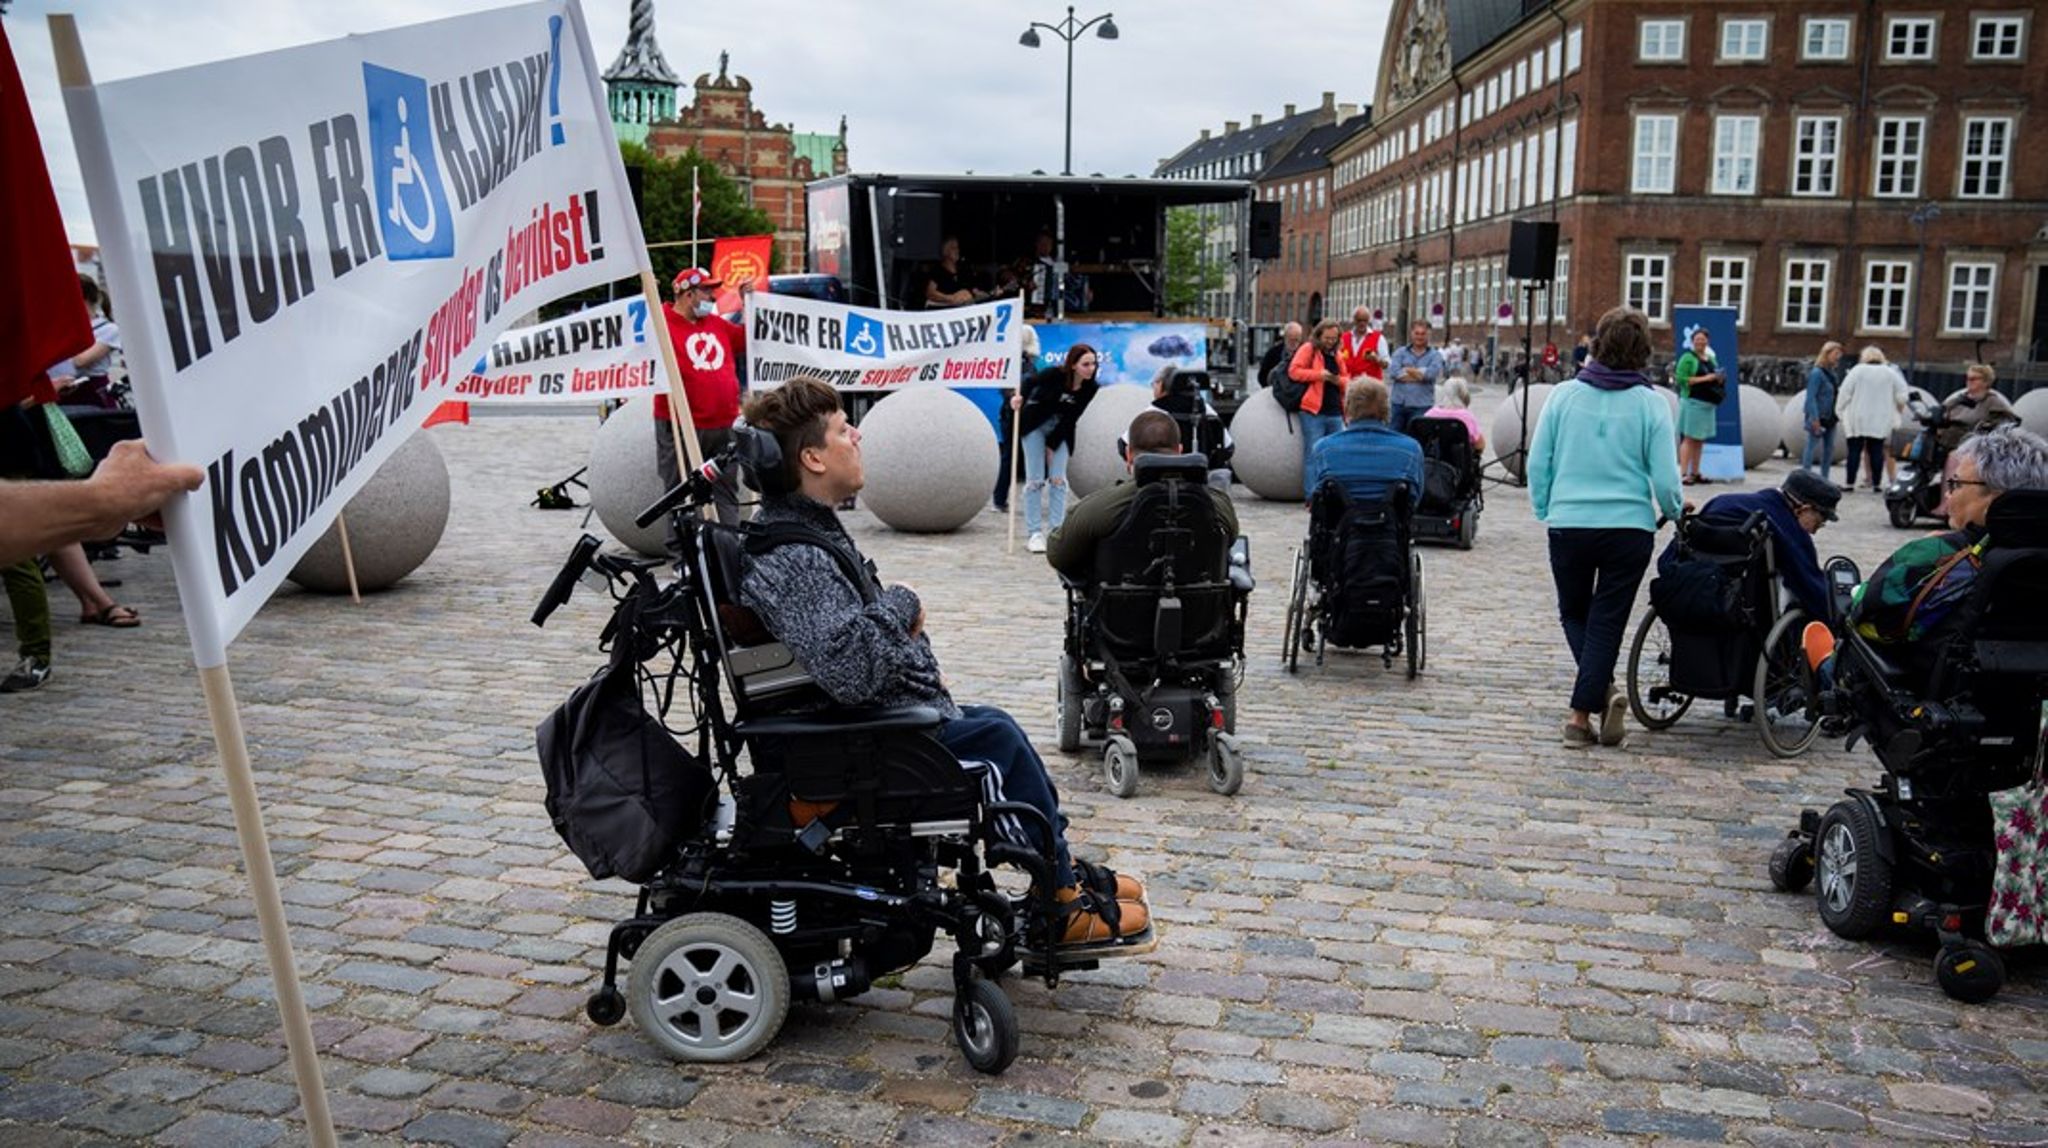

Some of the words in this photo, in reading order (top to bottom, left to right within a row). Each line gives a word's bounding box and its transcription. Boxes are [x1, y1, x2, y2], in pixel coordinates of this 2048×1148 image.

[138, 135, 315, 373] HVOR
[309, 113, 382, 279] ER
[754, 307, 810, 347] HVOR
[818, 317, 842, 350] ER
[207, 328, 422, 598] Kommunerne
[421, 266, 484, 391] snyder
[485, 247, 502, 324] os
[504, 189, 604, 303] bevidst!
[539, 373, 564, 394] os
[571, 359, 655, 392] bevidst!
[861, 365, 917, 387] snyder
[919, 361, 940, 380] os
[943, 357, 1010, 381] bevidst!
